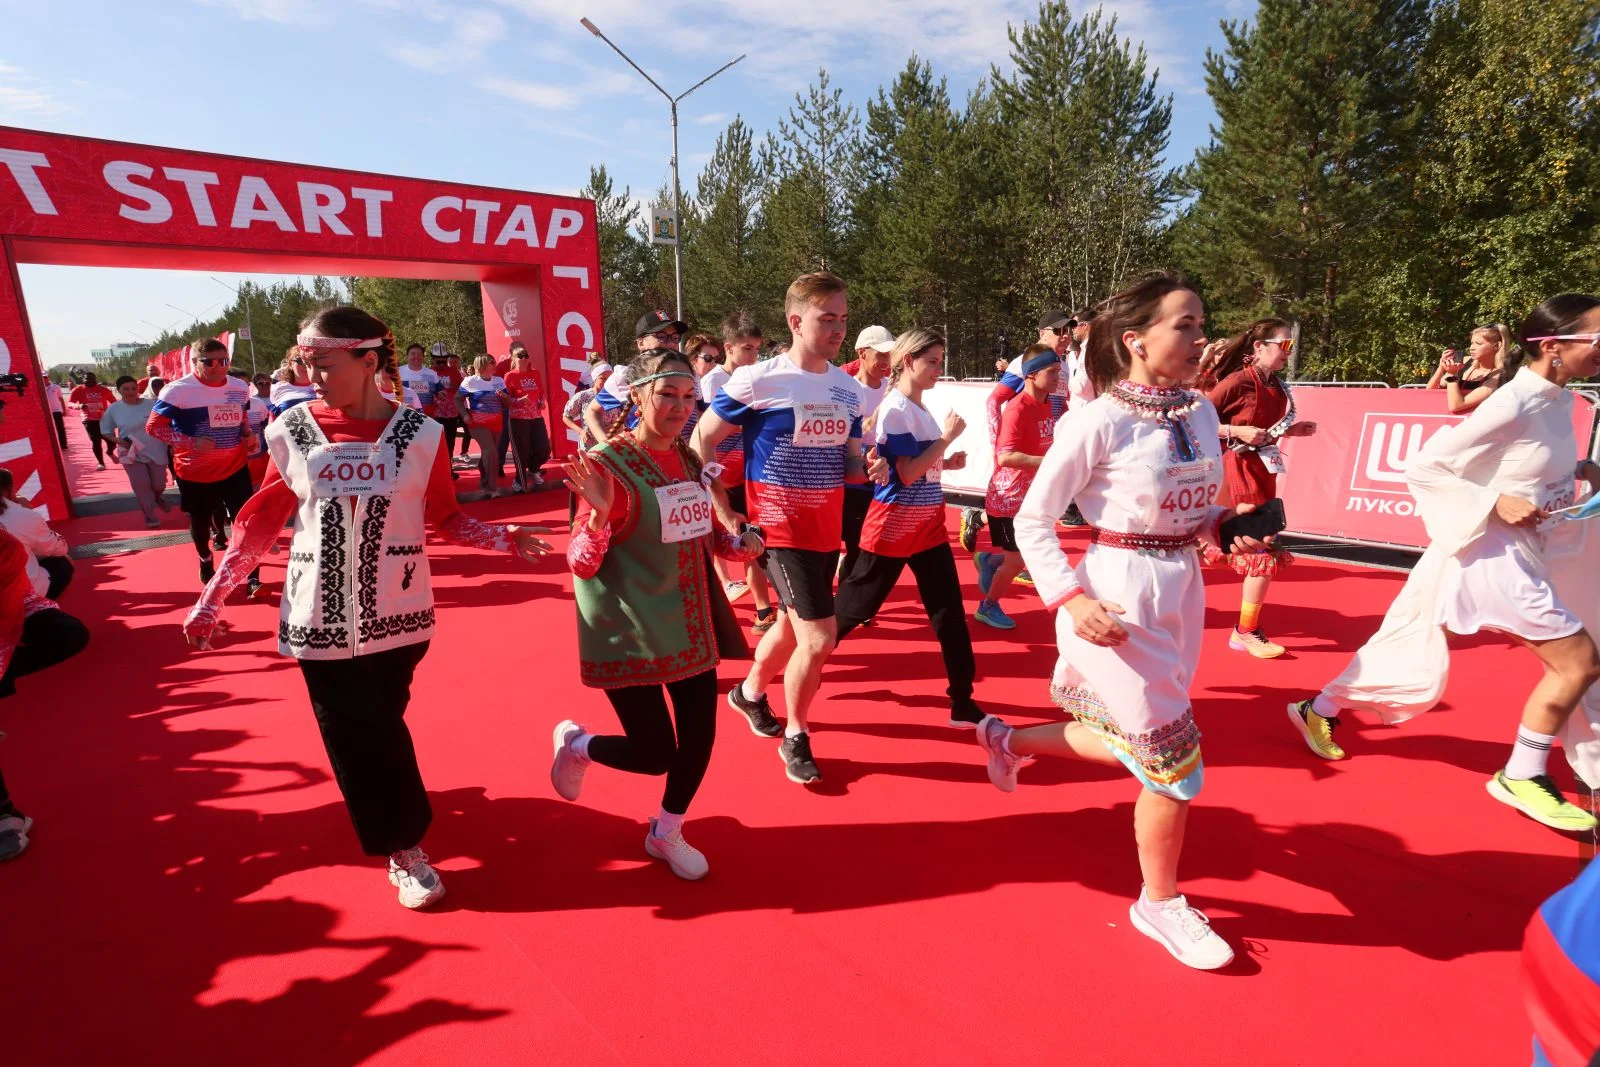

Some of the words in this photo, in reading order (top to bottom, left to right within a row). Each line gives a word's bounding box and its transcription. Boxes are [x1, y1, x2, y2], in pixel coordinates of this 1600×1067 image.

[102, 160, 394, 238] START
[421, 196, 584, 249] СТАР
[214, 412, 240, 421] 4018
[801, 419, 846, 435] 4089
[318, 462, 385, 481] 4001
[1160, 484, 1217, 513] 4028
[668, 501, 710, 526] 4088
